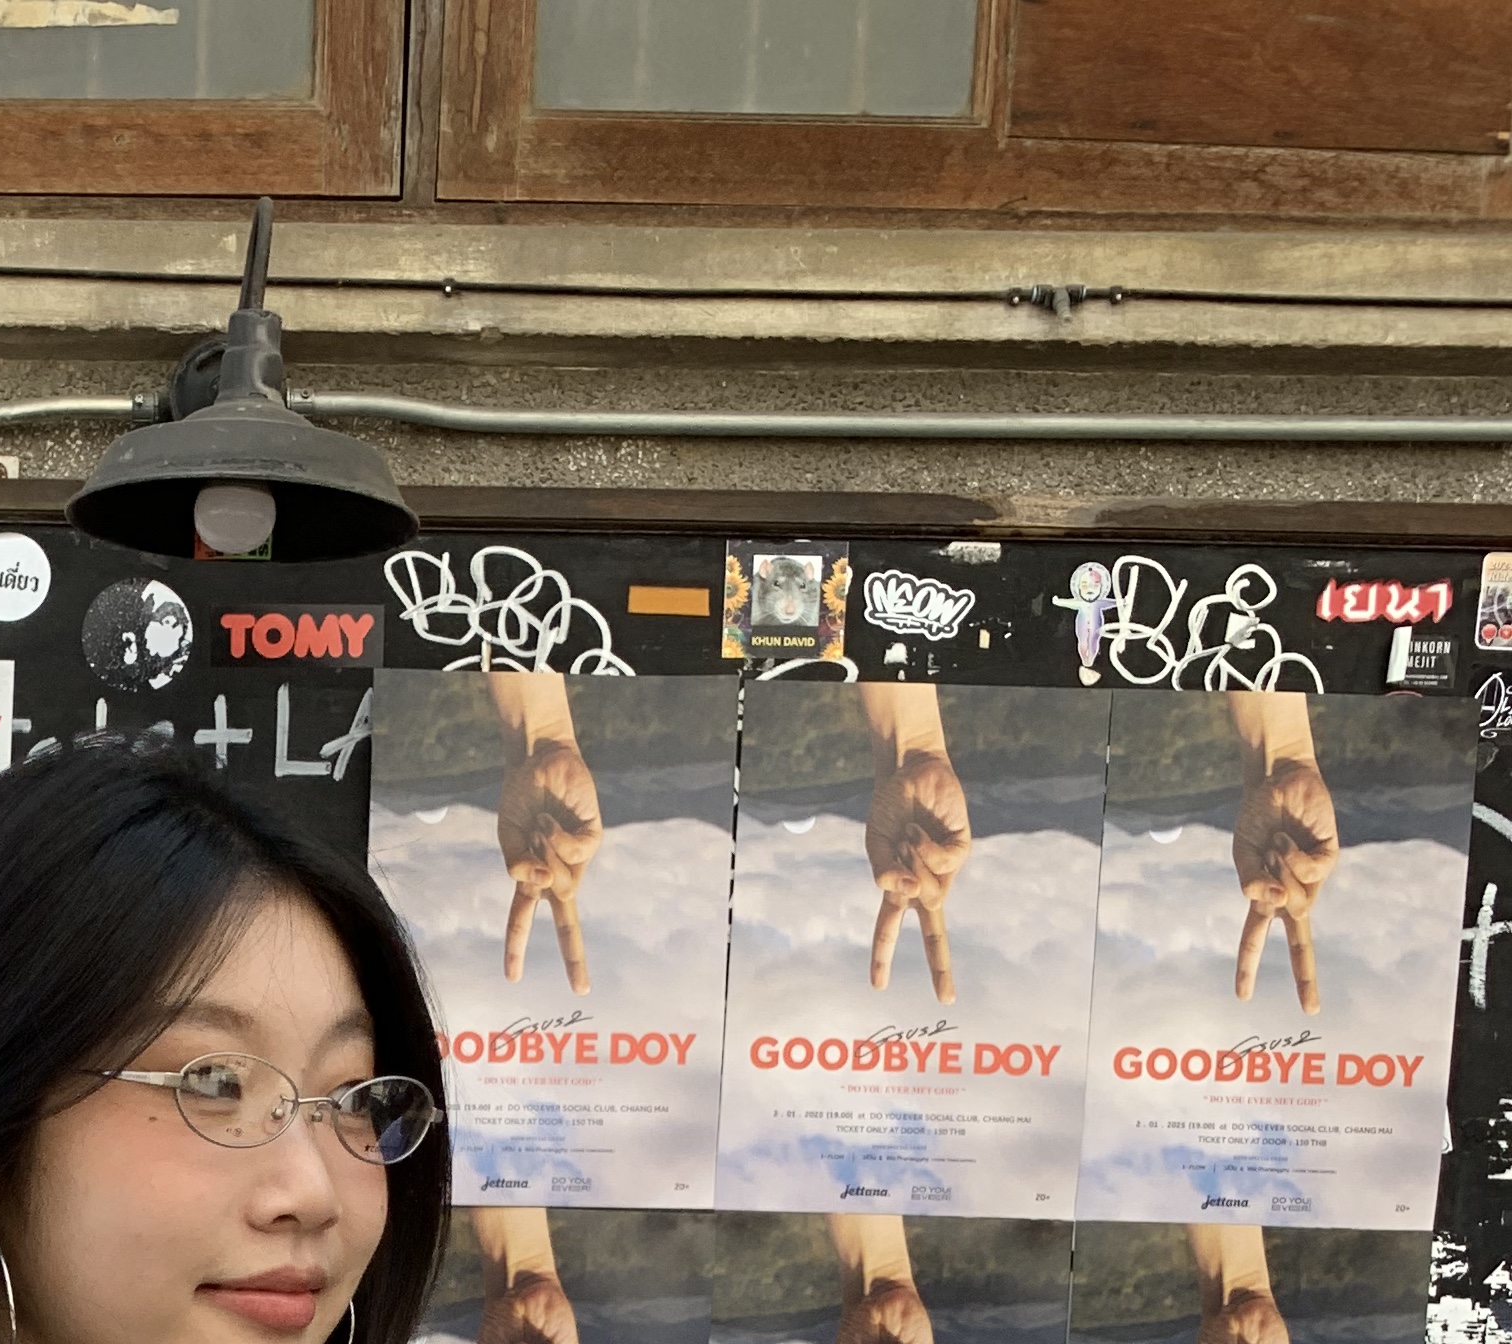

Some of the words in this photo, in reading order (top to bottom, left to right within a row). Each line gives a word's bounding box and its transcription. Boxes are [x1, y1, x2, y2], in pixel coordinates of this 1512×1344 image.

[220, 612, 375, 659] TOMY
[751, 636, 782, 647] KHUN
[783, 636, 816, 647] DAVID
[609, 1032, 697, 1066] DOY
[749, 1035, 963, 1075] GOODBYE
[973, 1042, 1062, 1077] DOY
[1112, 1045, 1326, 1086] GOODBYE
[1336, 1052, 1425, 1088] DOY
[1197, 1135, 1226, 1144] TICKET
[1286, 1124, 1316, 1133] SOCIAL
[1344, 1126, 1377, 1135] CHIANG
